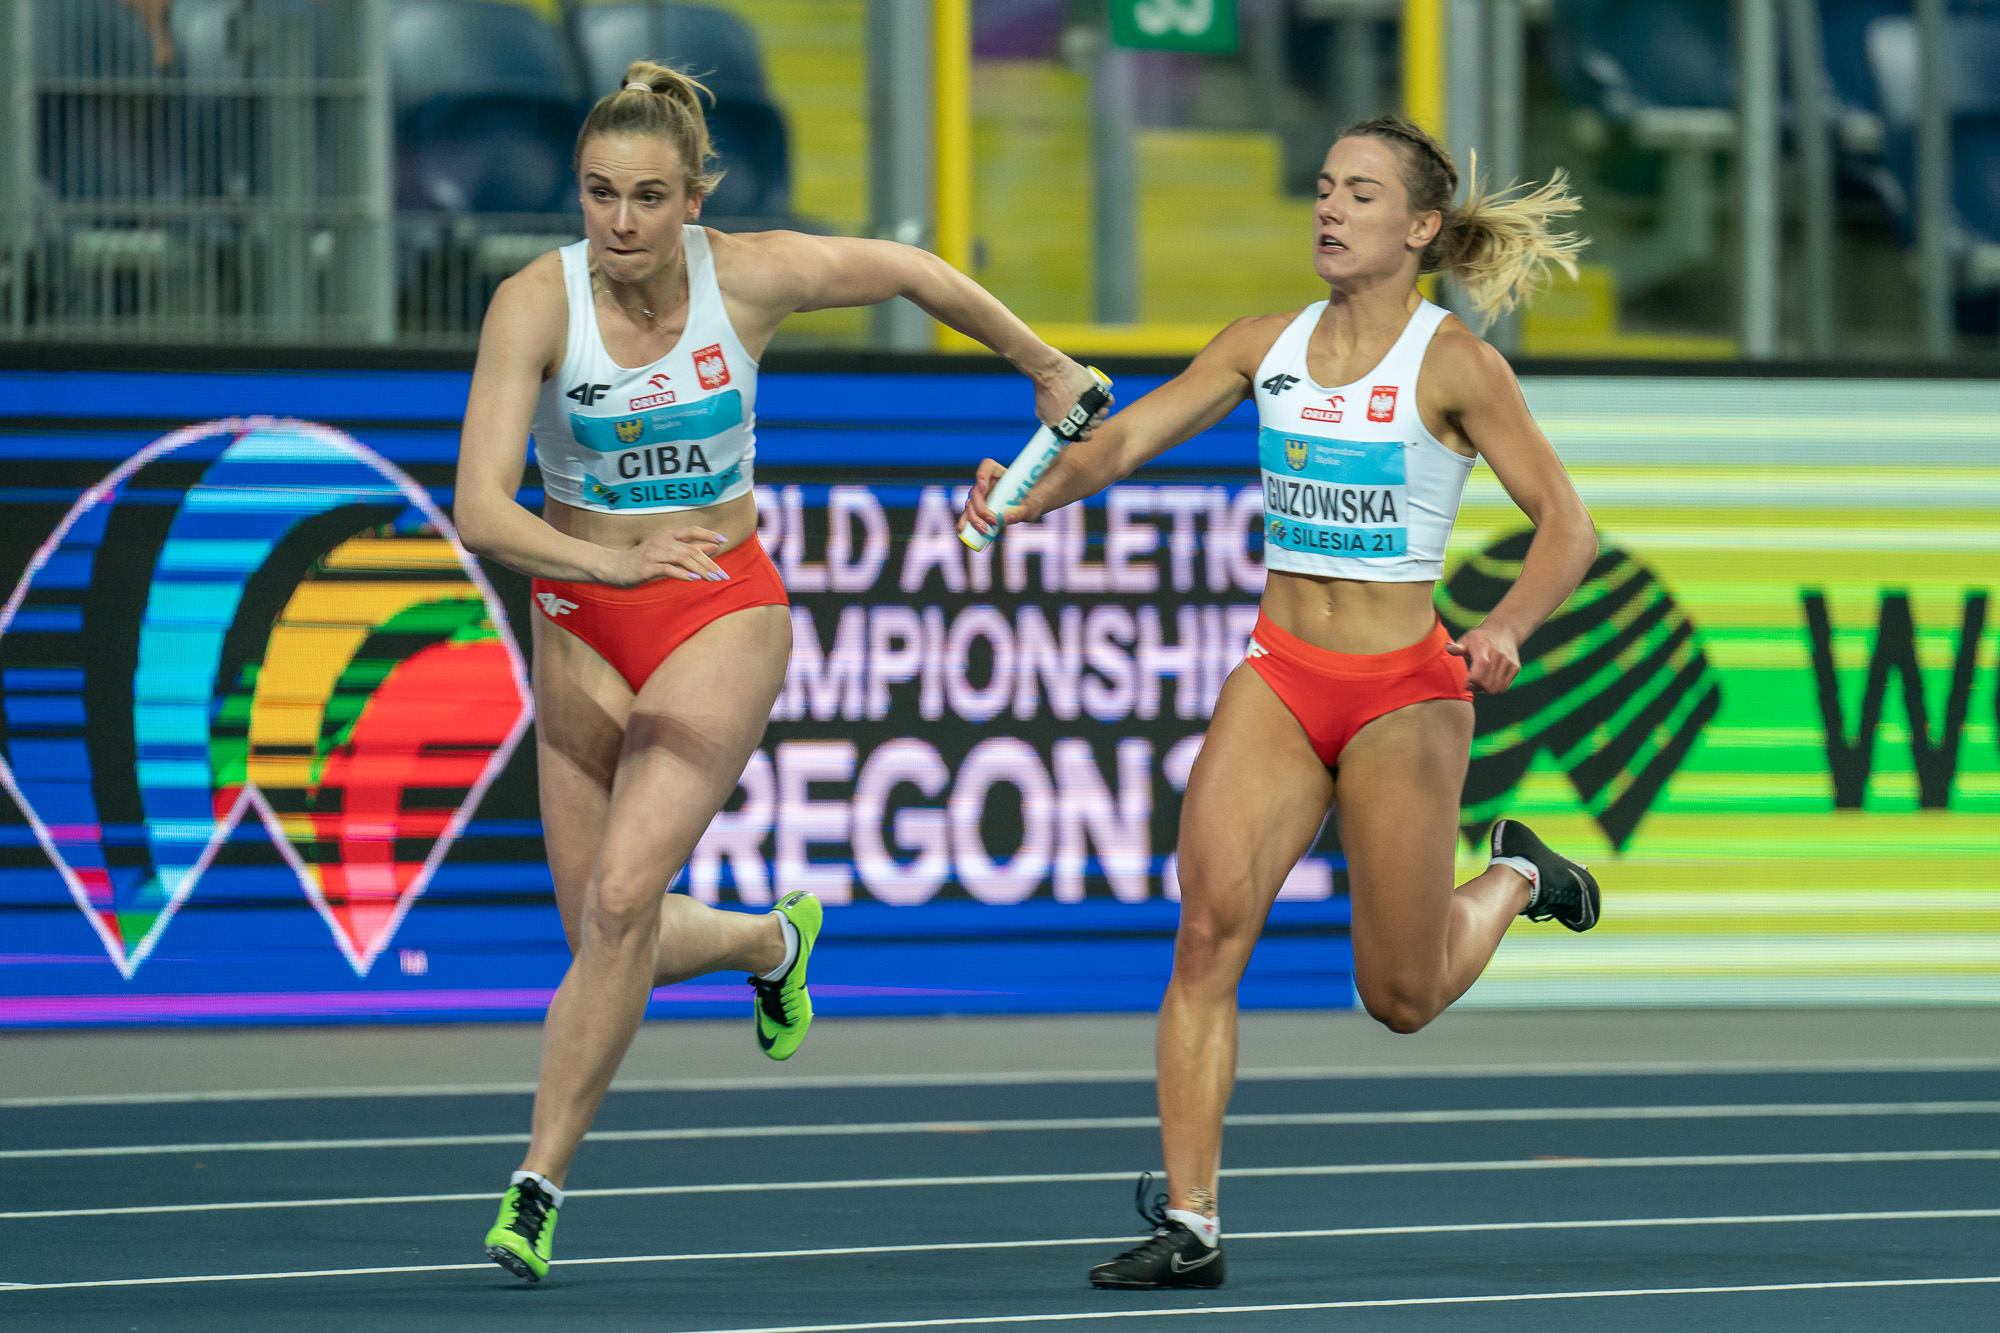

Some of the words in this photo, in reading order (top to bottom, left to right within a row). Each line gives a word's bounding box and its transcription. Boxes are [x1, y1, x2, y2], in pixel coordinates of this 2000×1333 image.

[567, 382, 612, 406] 4F
[1261, 373, 1301, 396] 4F
[632, 391, 675, 410] ORLEN
[1302, 408, 1342, 422] ORLEN
[618, 444, 712, 479] CIBA
[630, 481, 716, 503] SILESIA
[1266, 475, 1399, 524] GUZOWSKA
[1292, 527, 1366, 552] SILESIA
[1372, 533, 1394, 552] 21
[688, 736, 1153, 906] REGON
